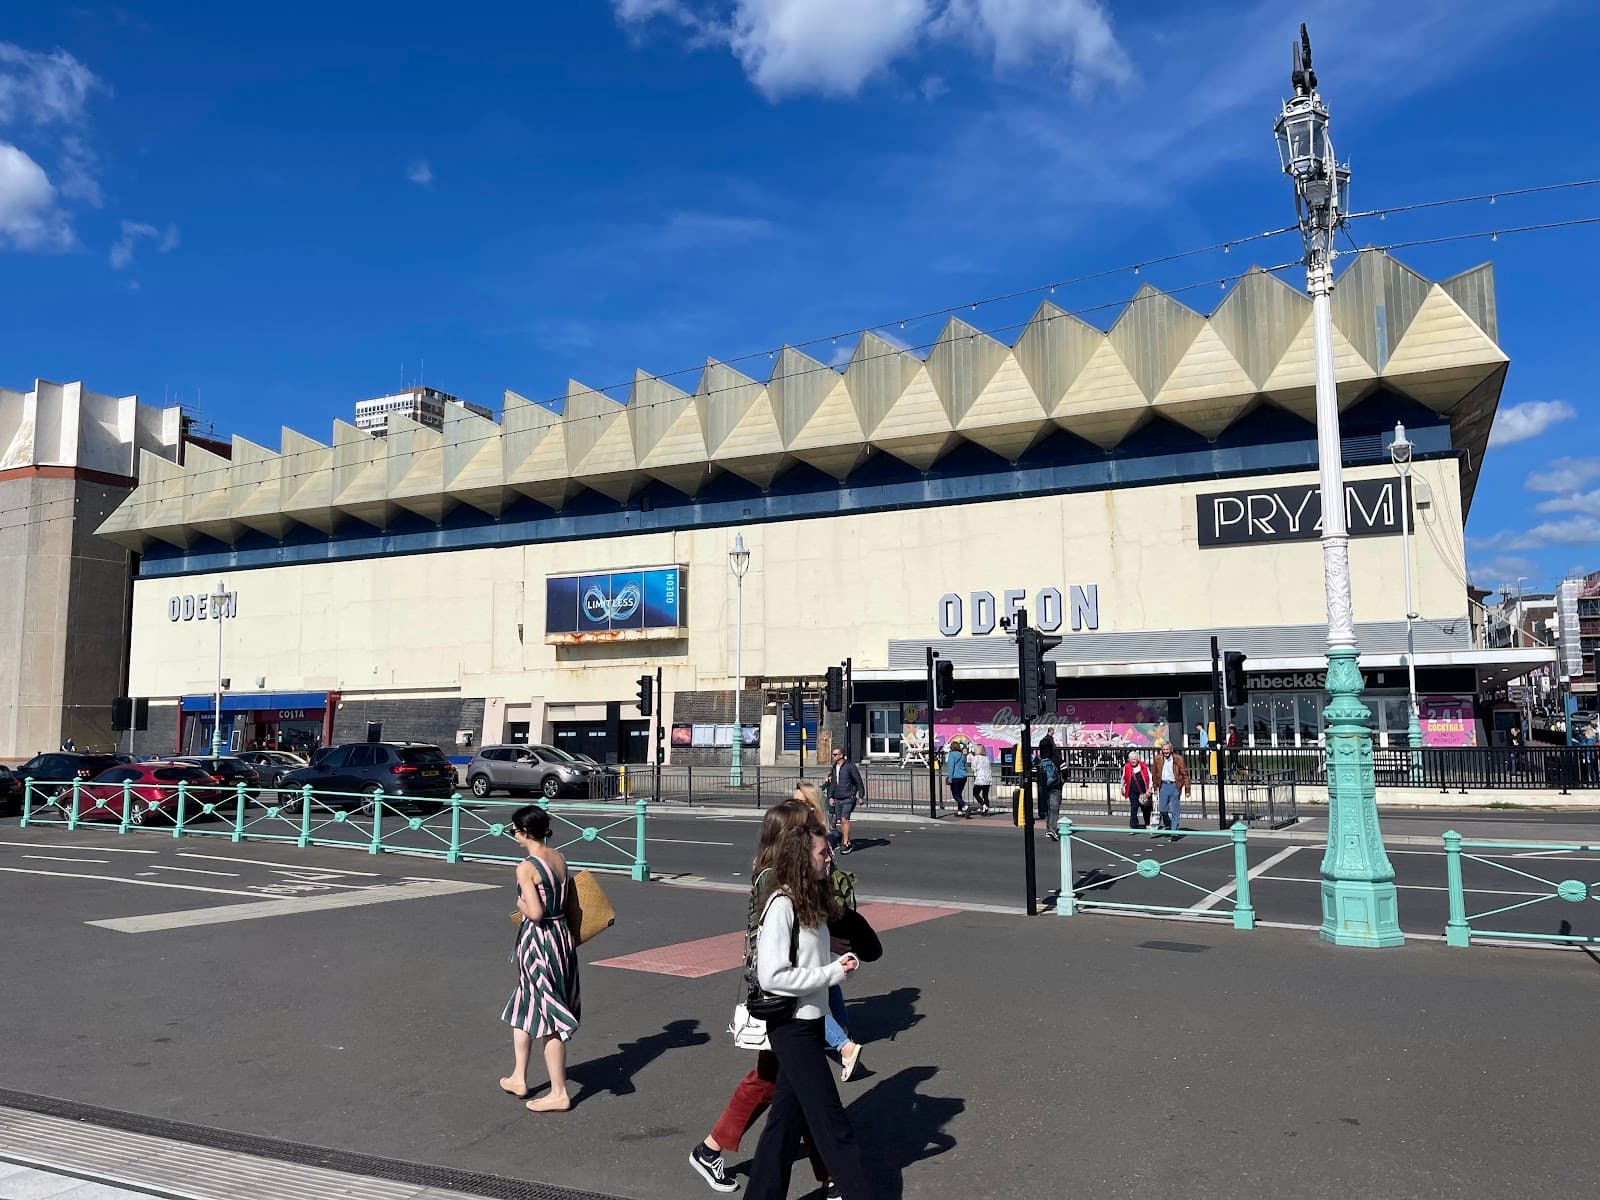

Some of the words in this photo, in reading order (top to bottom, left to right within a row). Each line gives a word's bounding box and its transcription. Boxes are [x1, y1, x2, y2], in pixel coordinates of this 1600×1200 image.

[665, 573, 674, 604] ODEON
[587, 597, 634, 610] LIMITLESS
[938, 583, 1099, 638] ODEON
[278, 709, 305, 719] COSTA
[1427, 723, 1465, 732] COCKTAILS
